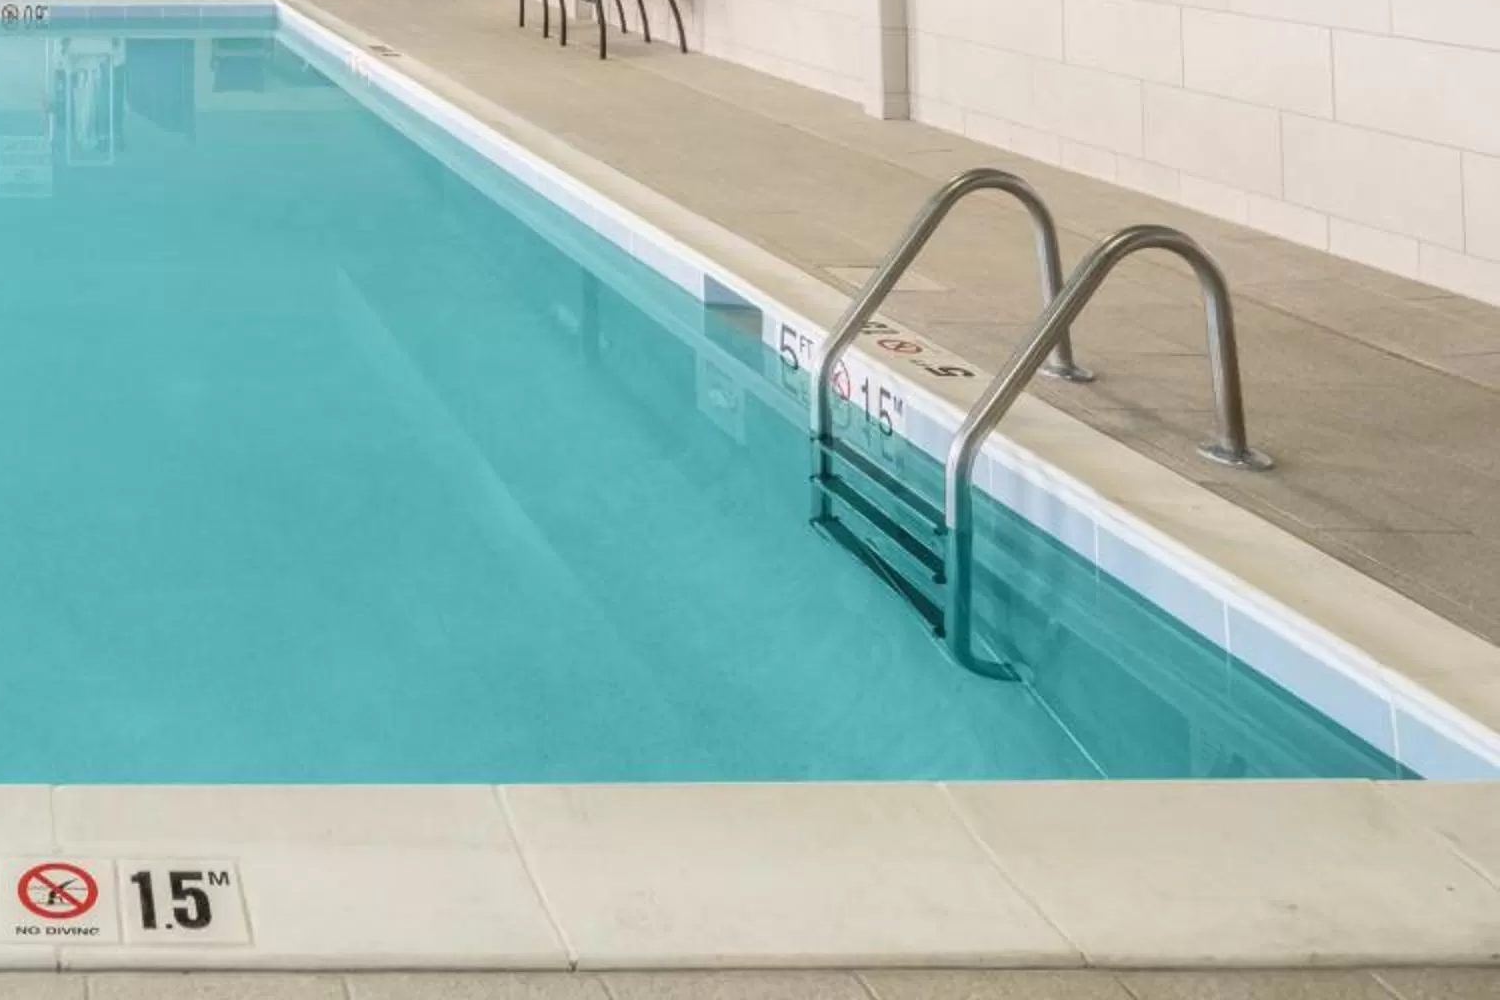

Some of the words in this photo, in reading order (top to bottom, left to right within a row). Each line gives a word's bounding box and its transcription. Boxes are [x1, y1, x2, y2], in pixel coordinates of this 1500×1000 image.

[779, 322, 799, 370] 5
[799, 335, 815, 359] FT
[129, 870, 213, 931] 1.5
[207, 870, 231, 887] M
[14, 925, 41, 936] NO
